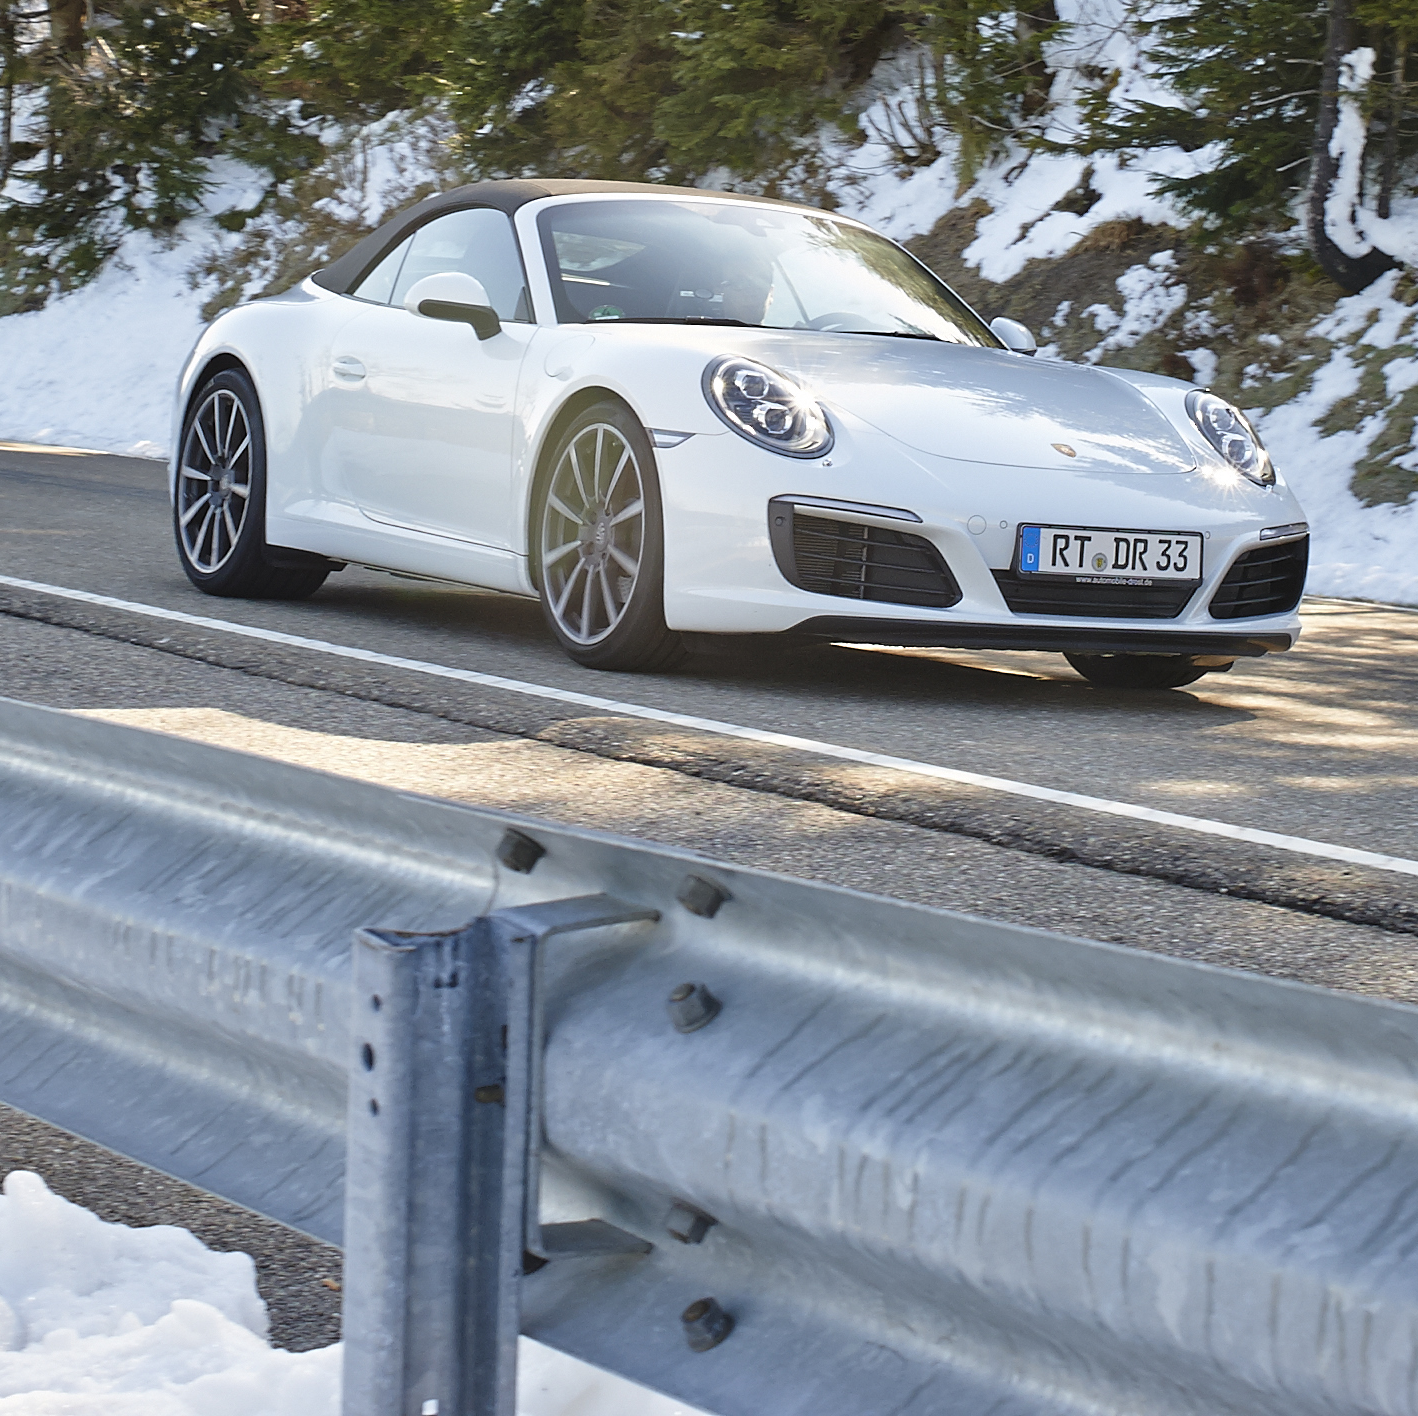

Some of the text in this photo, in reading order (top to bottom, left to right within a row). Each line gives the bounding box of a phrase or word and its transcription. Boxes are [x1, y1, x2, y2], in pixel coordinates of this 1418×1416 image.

[1026, 553, 1035, 564] D
[1051, 534, 1189, 572] RT DR 33
